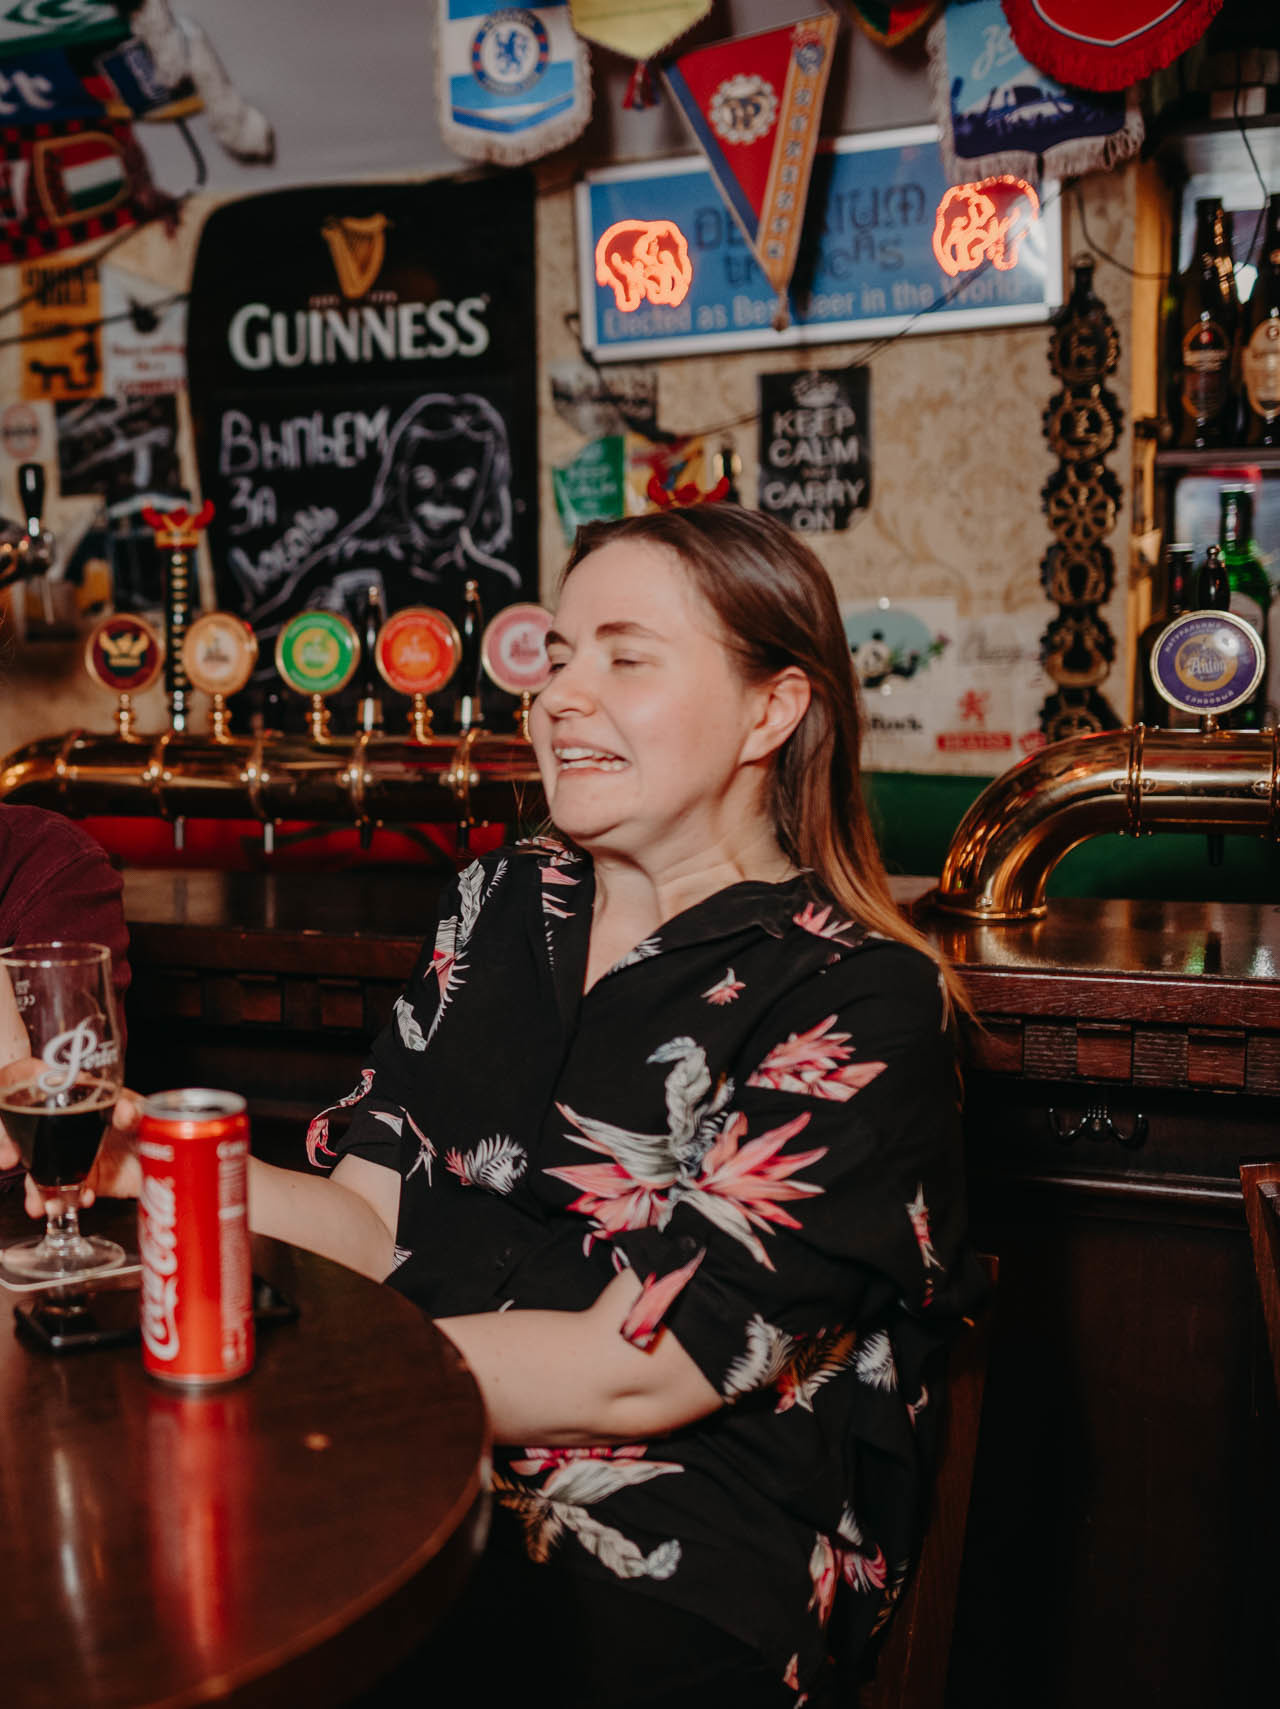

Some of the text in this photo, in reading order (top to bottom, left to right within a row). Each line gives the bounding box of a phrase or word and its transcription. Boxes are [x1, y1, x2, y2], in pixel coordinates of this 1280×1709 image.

[696, 303, 728, 330] as
[861, 283, 886, 312] in
[892, 279, 934, 309] the
[228, 297, 490, 371] GUINNESS
[773, 407, 857, 438] KEEP
[769, 436, 860, 468] CALM
[763, 478, 866, 510] CARRY
[791, 507, 836, 531] ON
